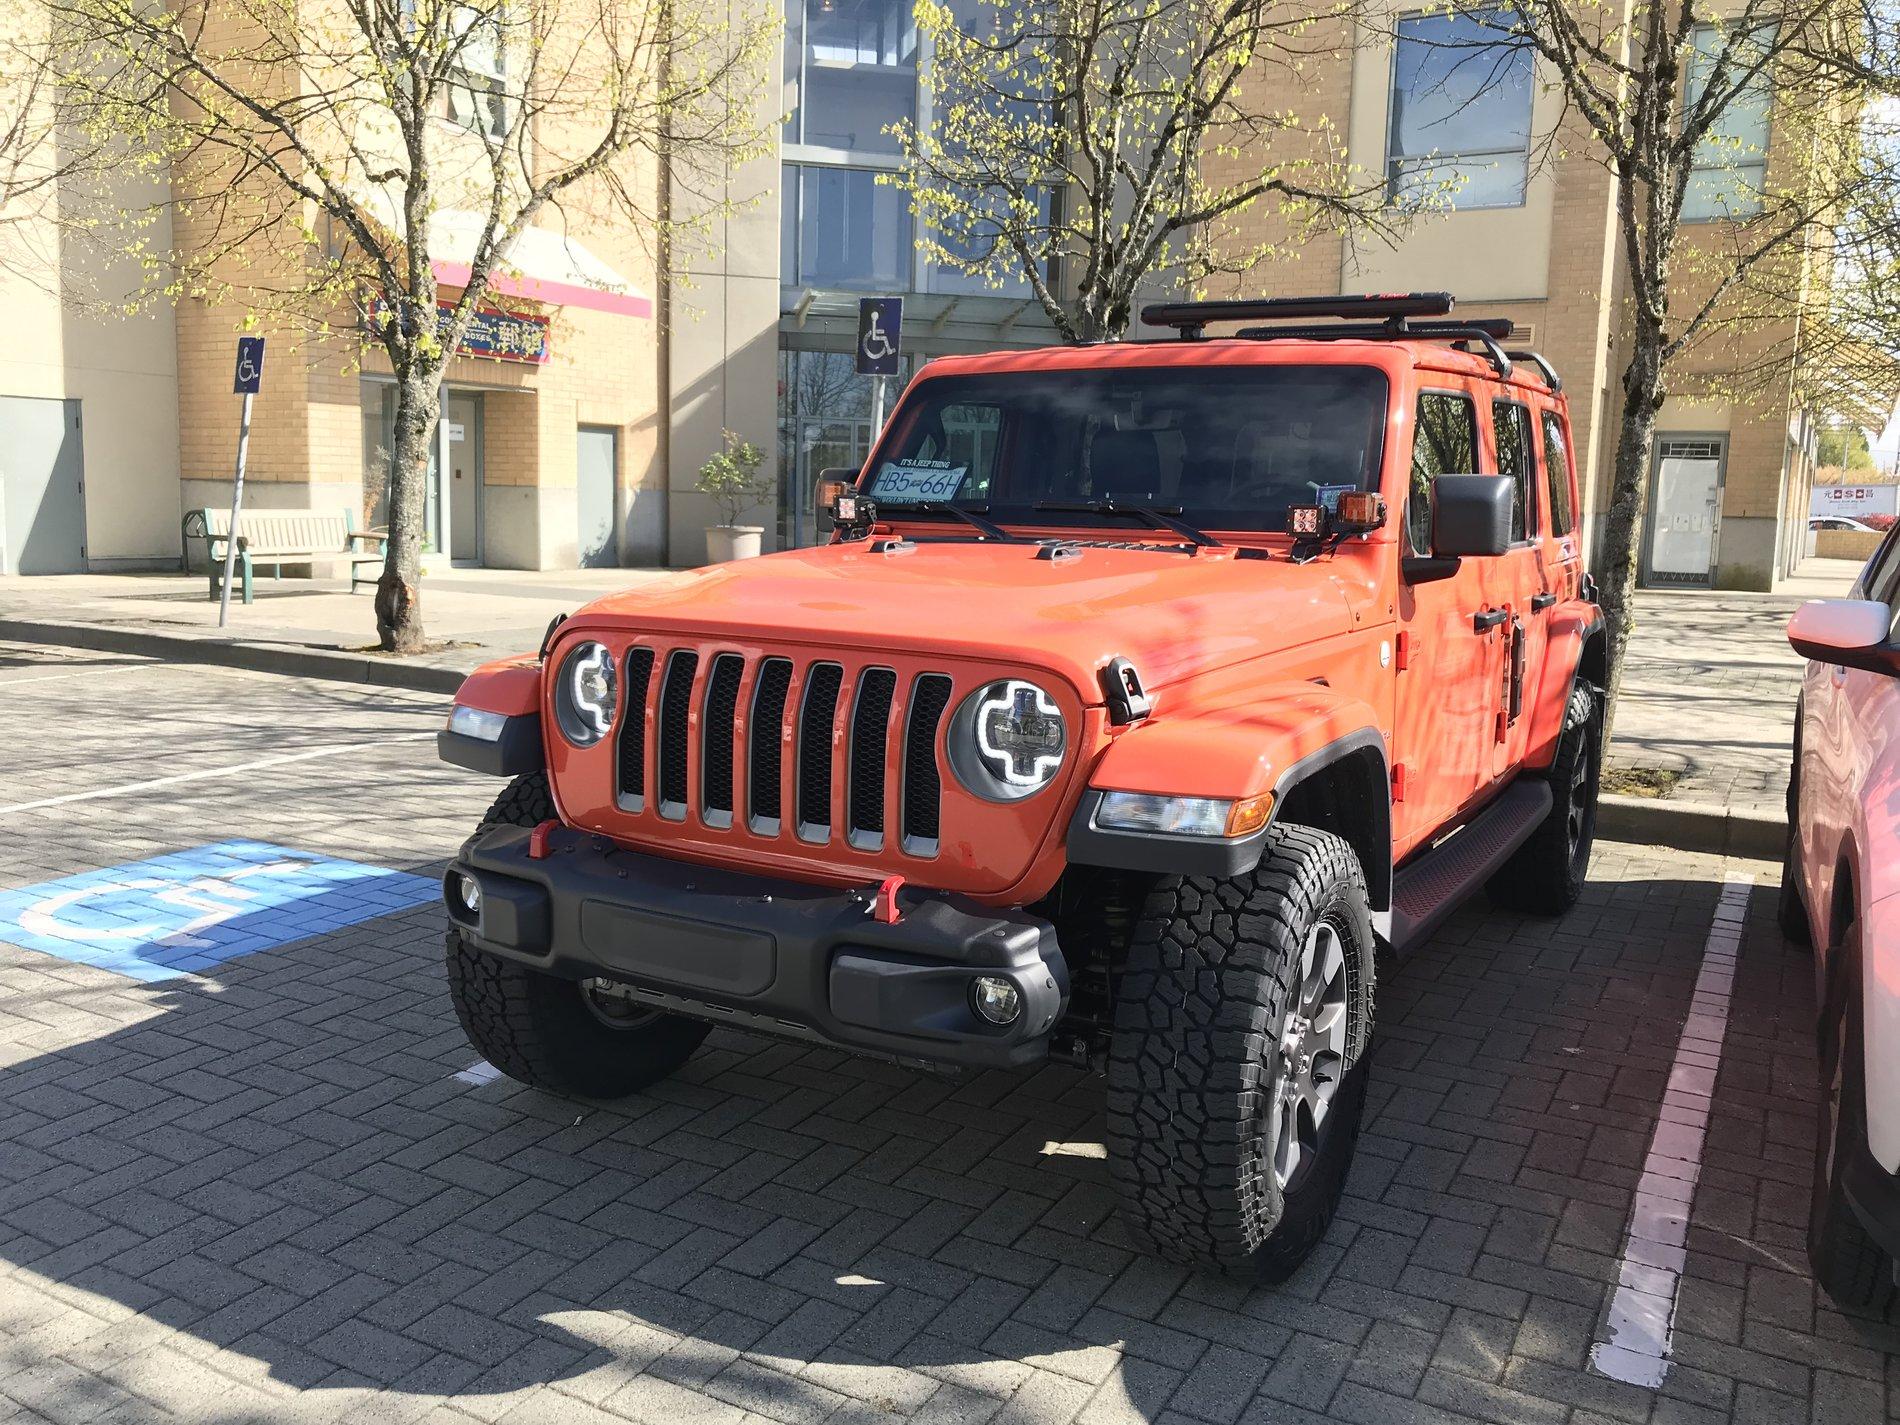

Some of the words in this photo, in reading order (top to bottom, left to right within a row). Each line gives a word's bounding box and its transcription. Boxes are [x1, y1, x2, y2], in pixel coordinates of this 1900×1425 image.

[464, 332, 491, 342] BOXES
[872, 472, 913, 492] HB5
[920, 474, 961, 495] 66H
